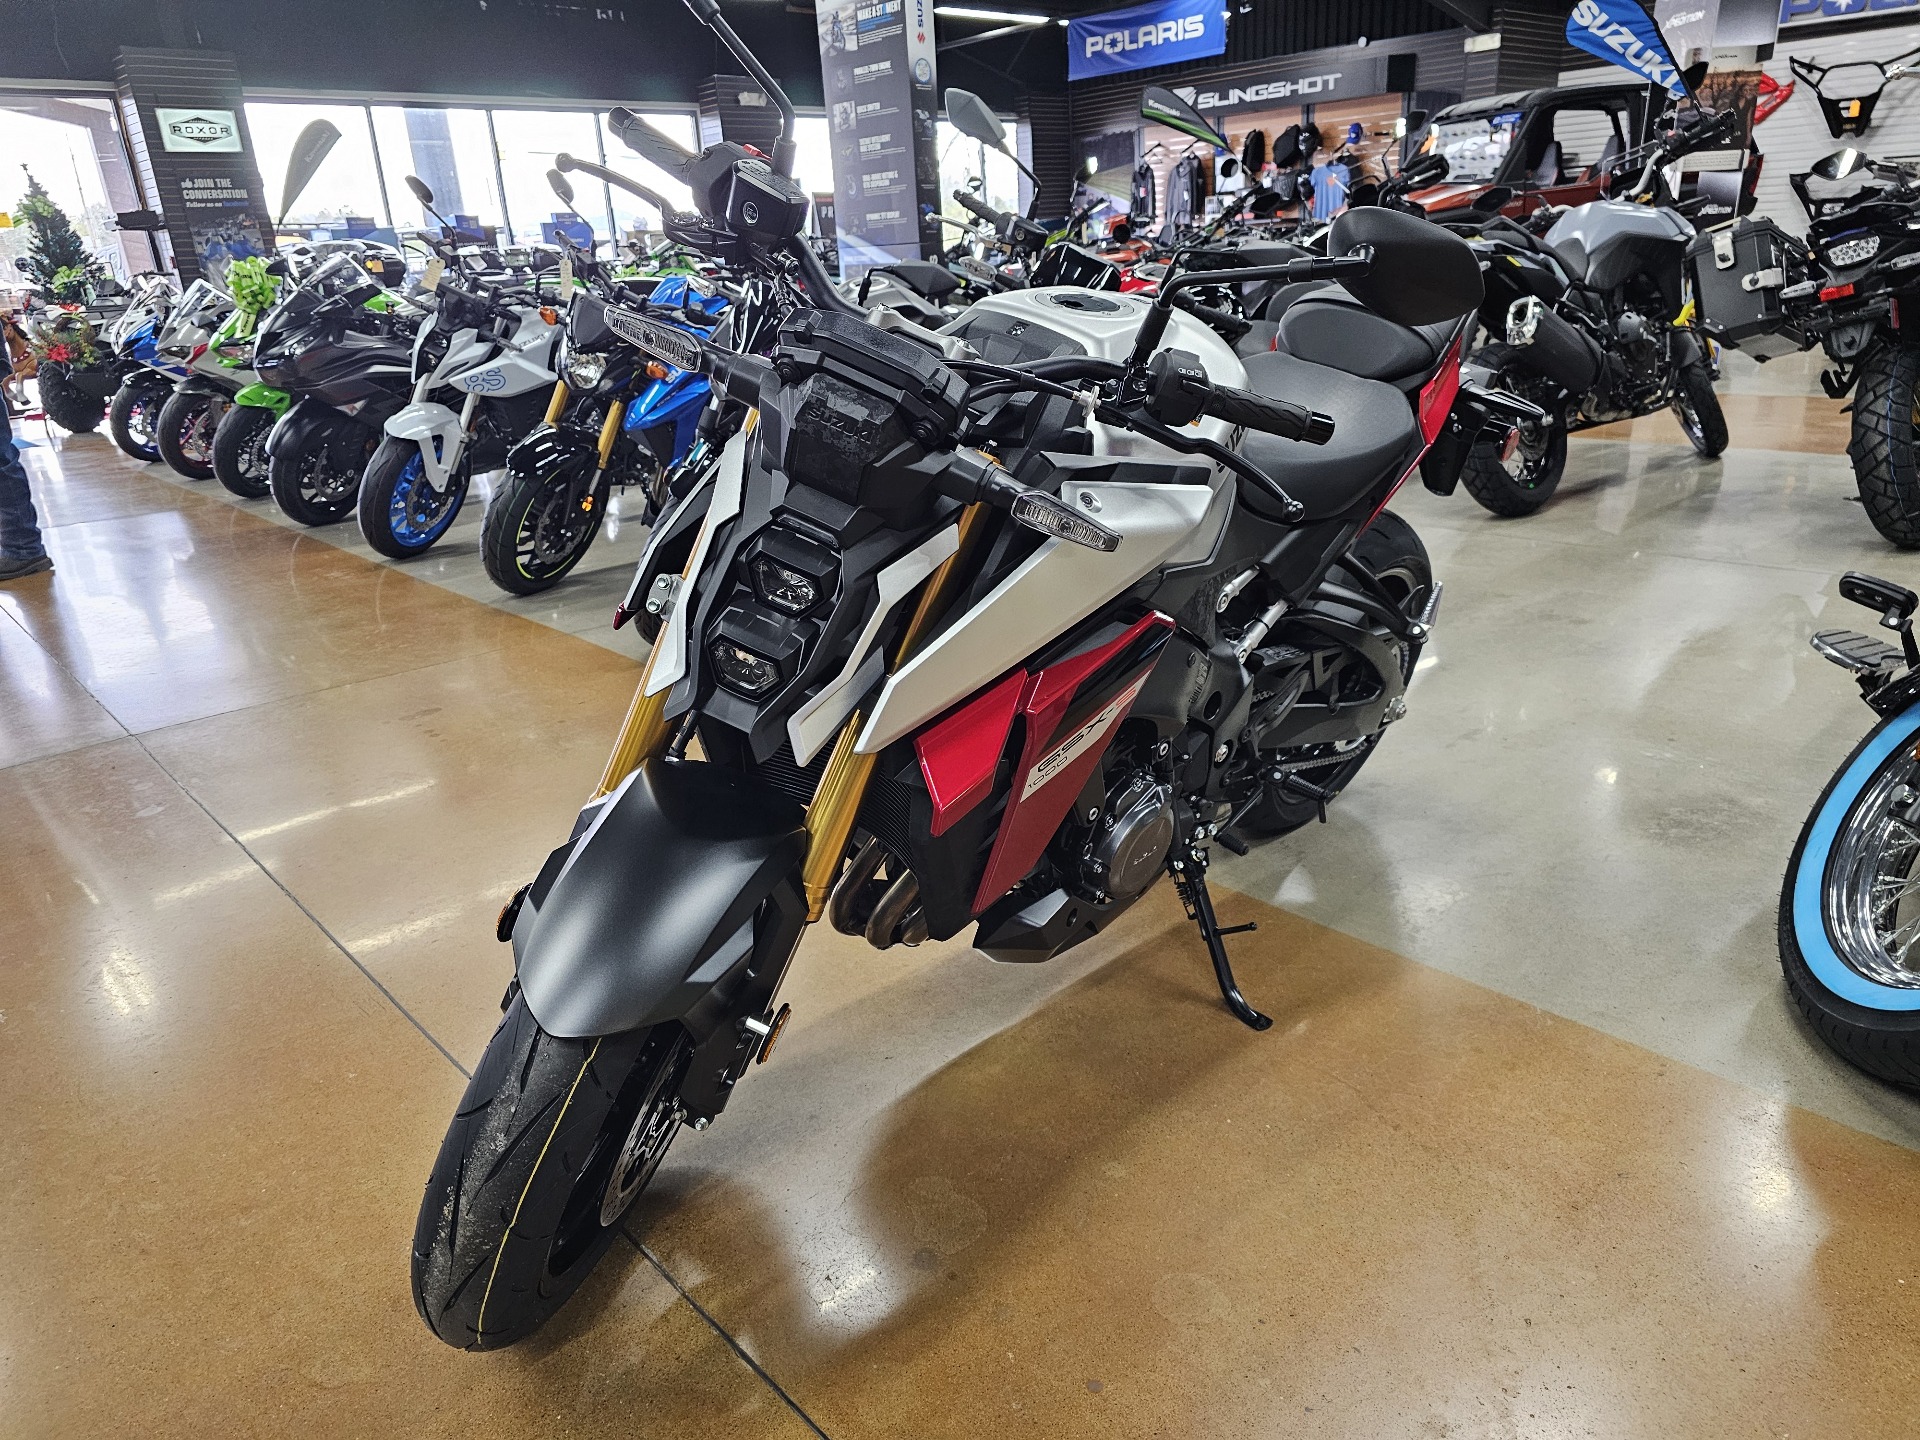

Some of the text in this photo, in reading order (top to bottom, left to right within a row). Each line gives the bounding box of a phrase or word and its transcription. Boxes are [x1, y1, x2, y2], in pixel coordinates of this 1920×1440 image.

[1085, 14, 1206, 58] POLARIS
[1571, 0, 1681, 90] SUZUKI
[1197, 73, 1342, 110] SLINGSHOT
[172, 125, 231, 135] ROXOR
[182, 189, 249, 200] CONVERSATION
[193, 178, 233, 188] JOIN THE
[807, 407, 874, 445] SUZUKI
[1028, 756, 1068, 789] 1000
